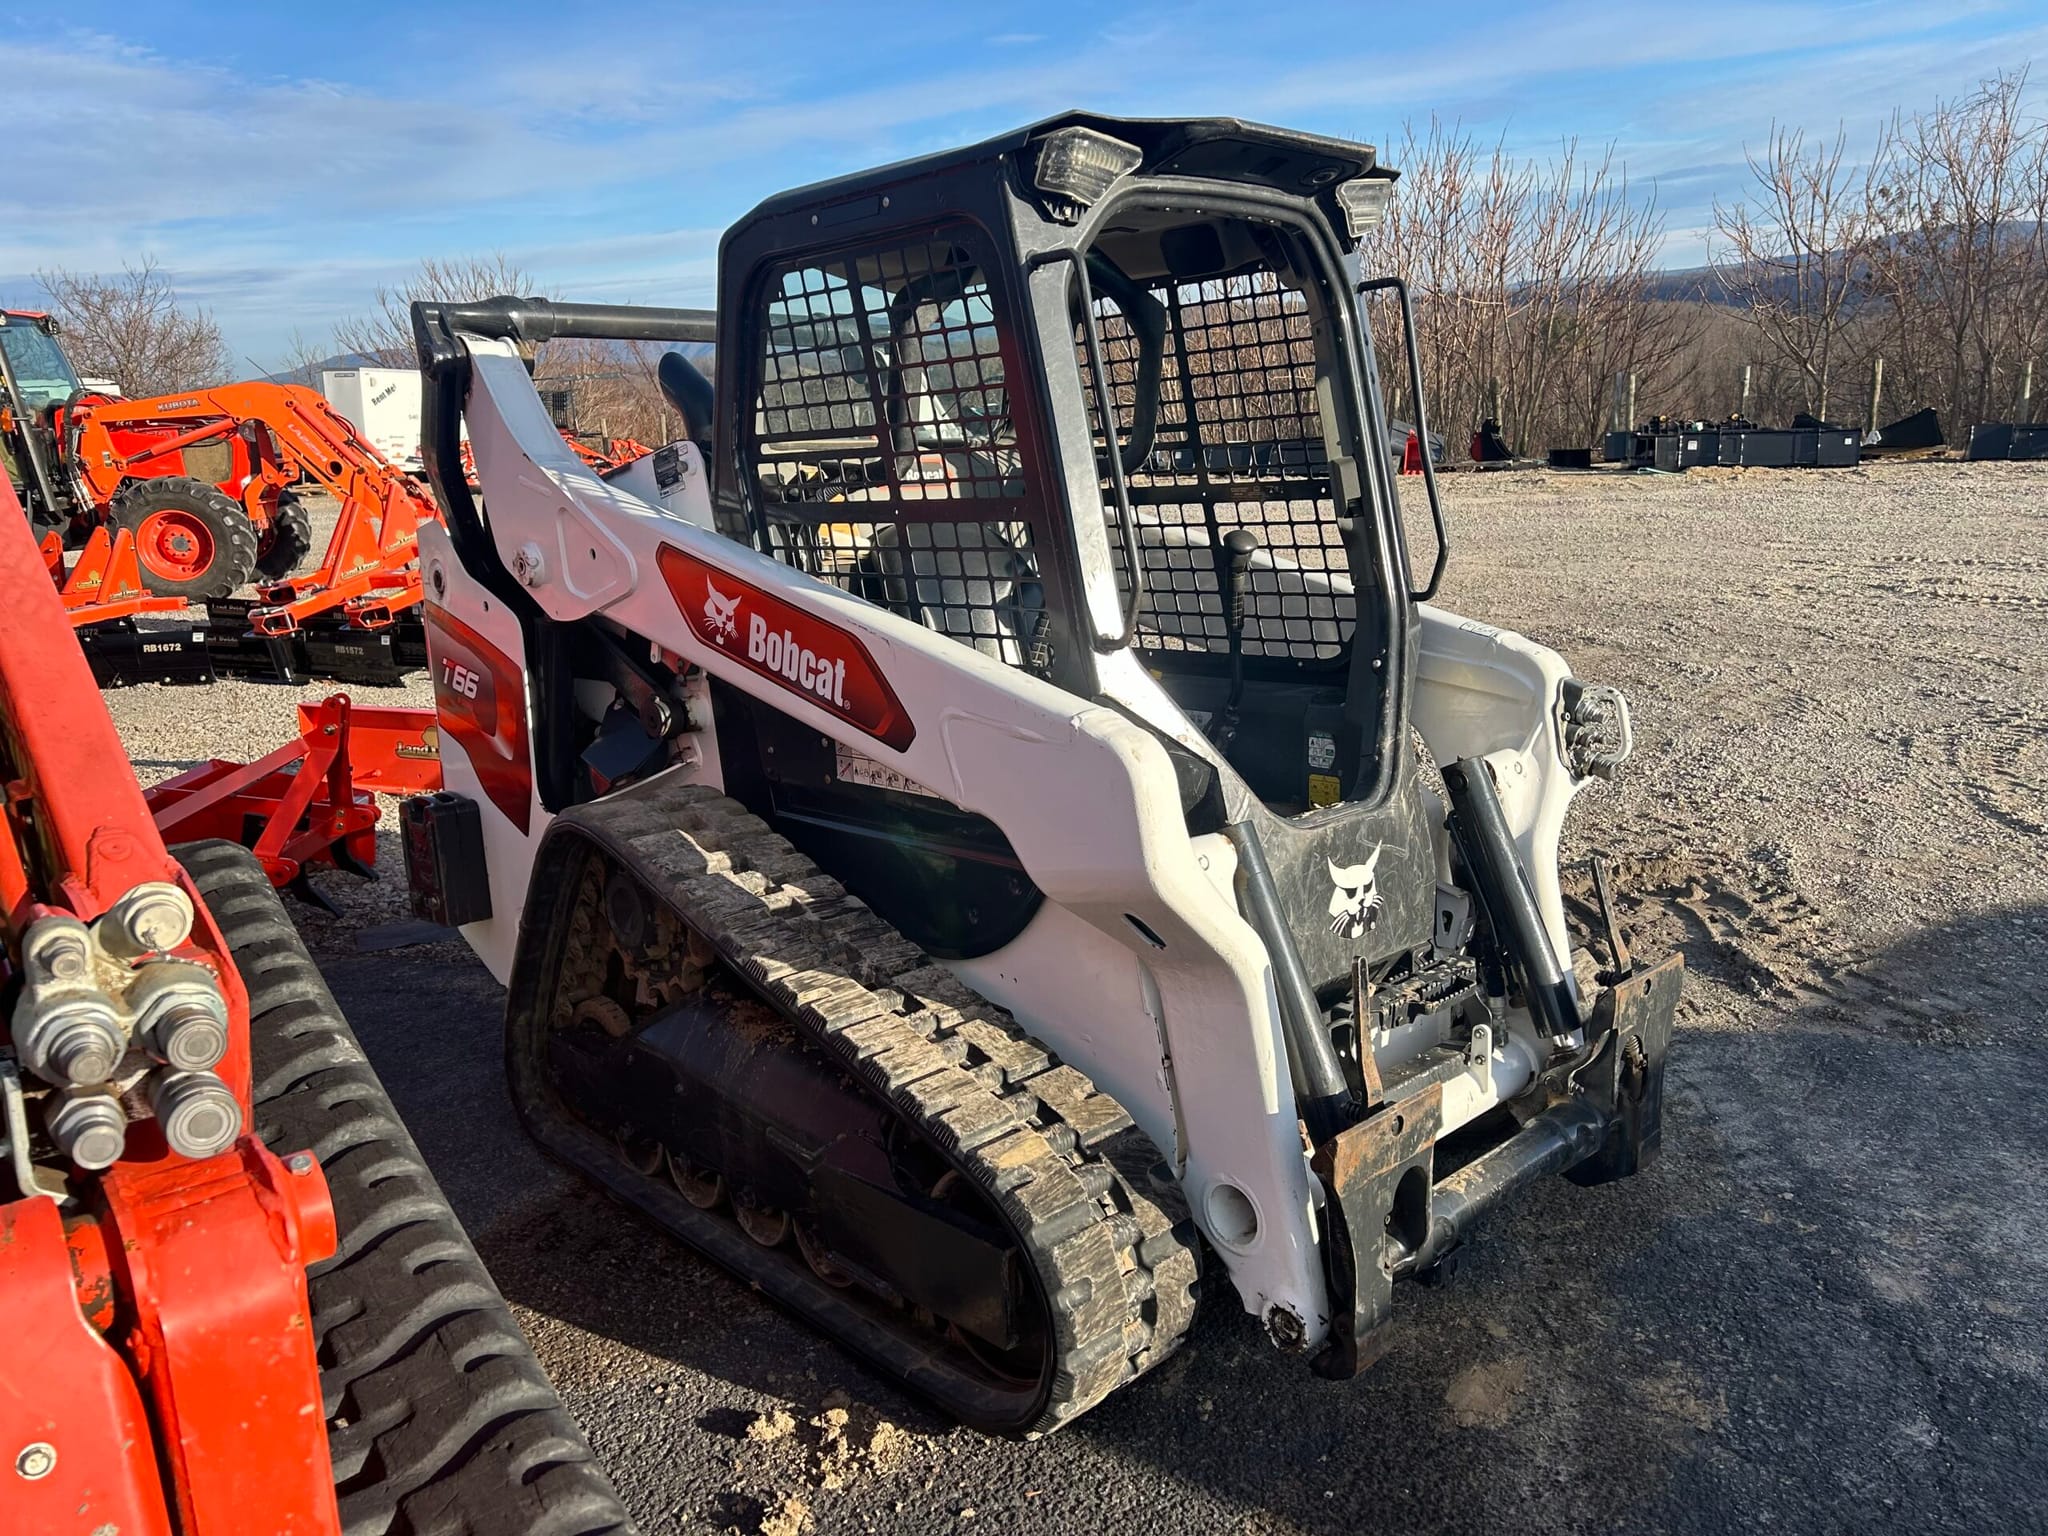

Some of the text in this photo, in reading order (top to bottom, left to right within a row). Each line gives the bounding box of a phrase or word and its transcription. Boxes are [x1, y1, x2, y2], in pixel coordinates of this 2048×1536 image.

[157, 399, 200, 412] KUBOTA
[371, 383, 397, 406] Rent Me!
[748, 612, 845, 707] Bobcat
[442, 657, 480, 700] T66
[398, 742, 429, 753] Land
